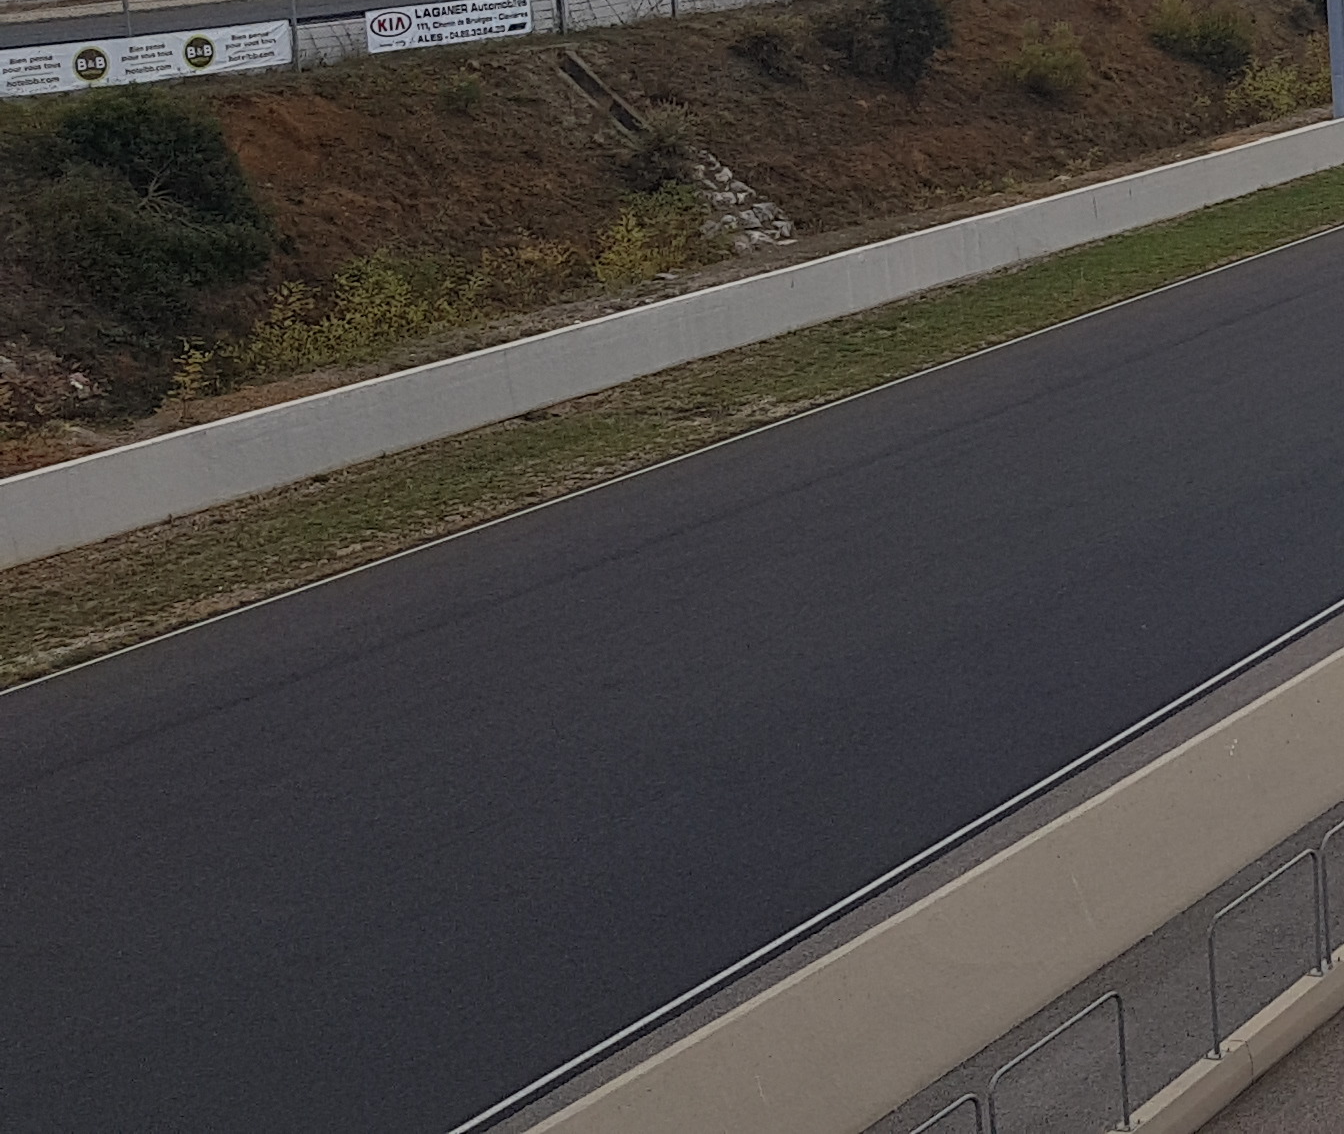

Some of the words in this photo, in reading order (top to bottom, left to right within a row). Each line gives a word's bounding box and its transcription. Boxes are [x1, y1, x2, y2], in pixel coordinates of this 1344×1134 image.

[377, 17, 406, 33] KIA
[186, 44, 213, 59] B&B
[77, 56, 106, 71] B&B
